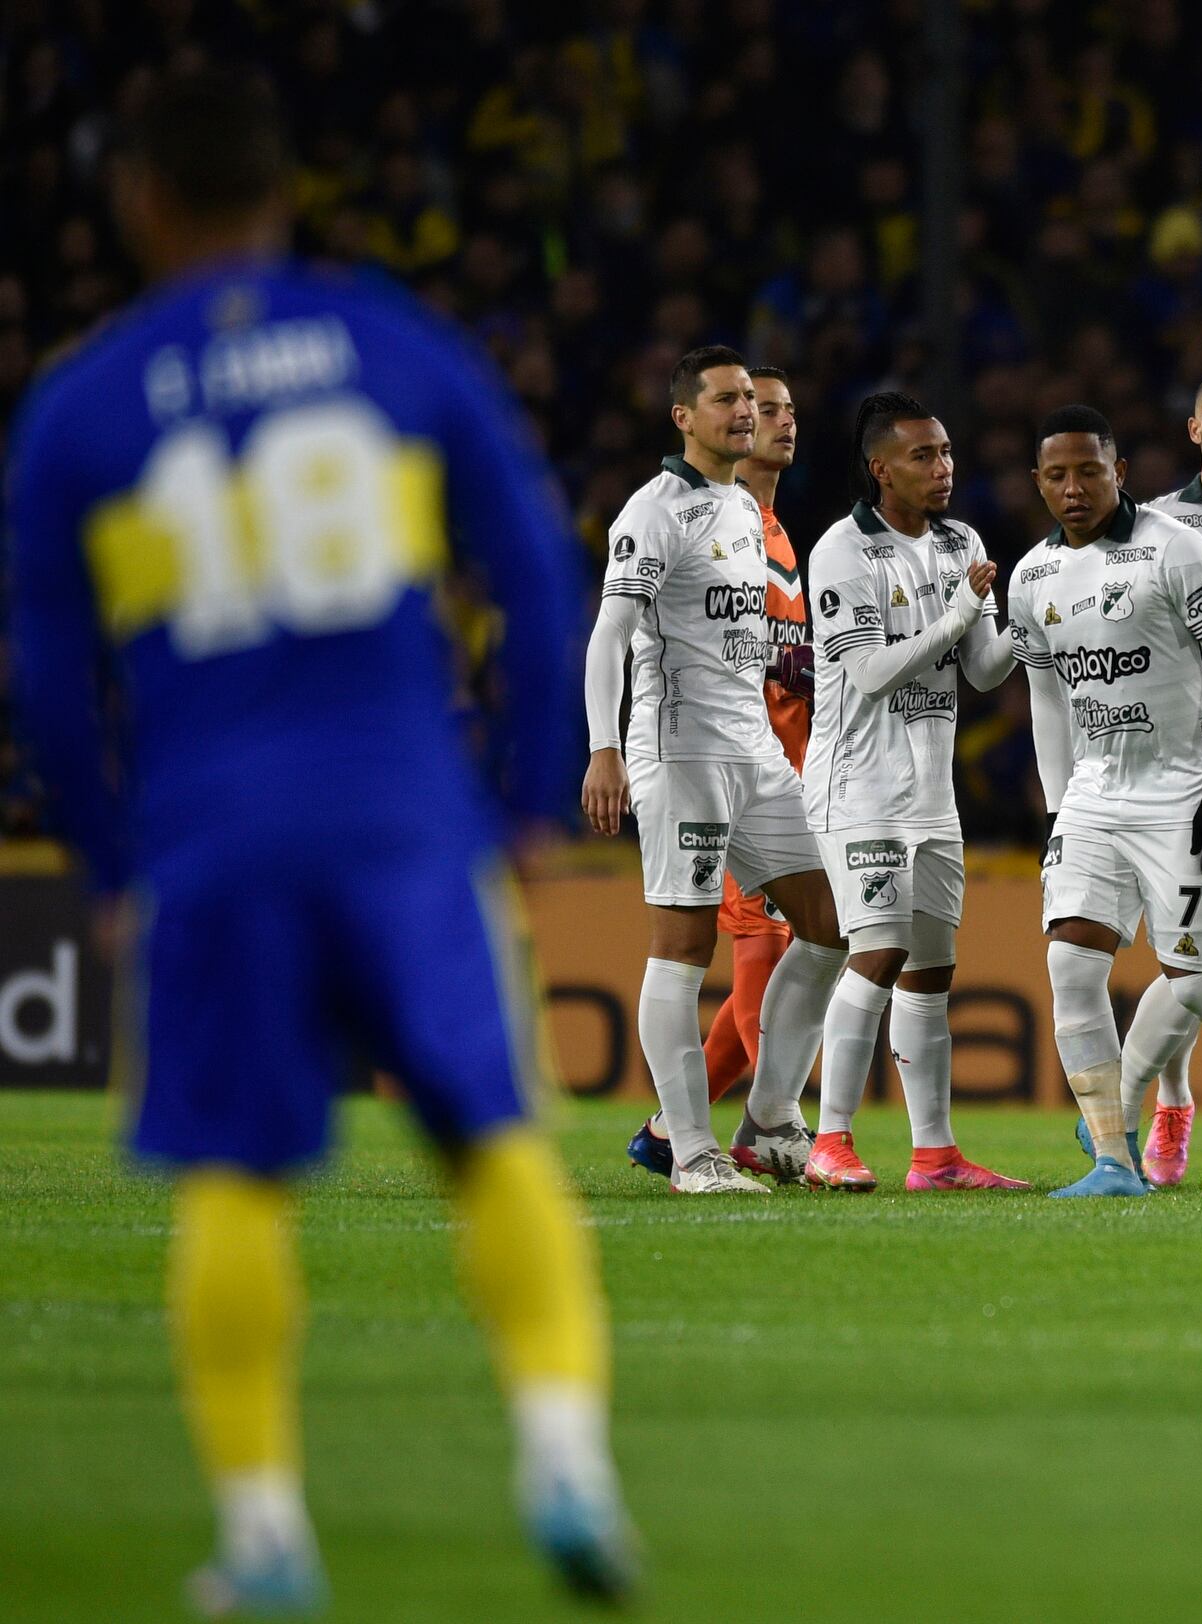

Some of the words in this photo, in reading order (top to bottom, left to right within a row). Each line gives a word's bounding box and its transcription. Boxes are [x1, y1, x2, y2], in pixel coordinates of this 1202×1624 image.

[137, 392, 398, 660] 18
[1106, 547, 1156, 565] POSTOBON
[848, 850, 908, 867] Chunky
[1179, 885, 1202, 928] 7
